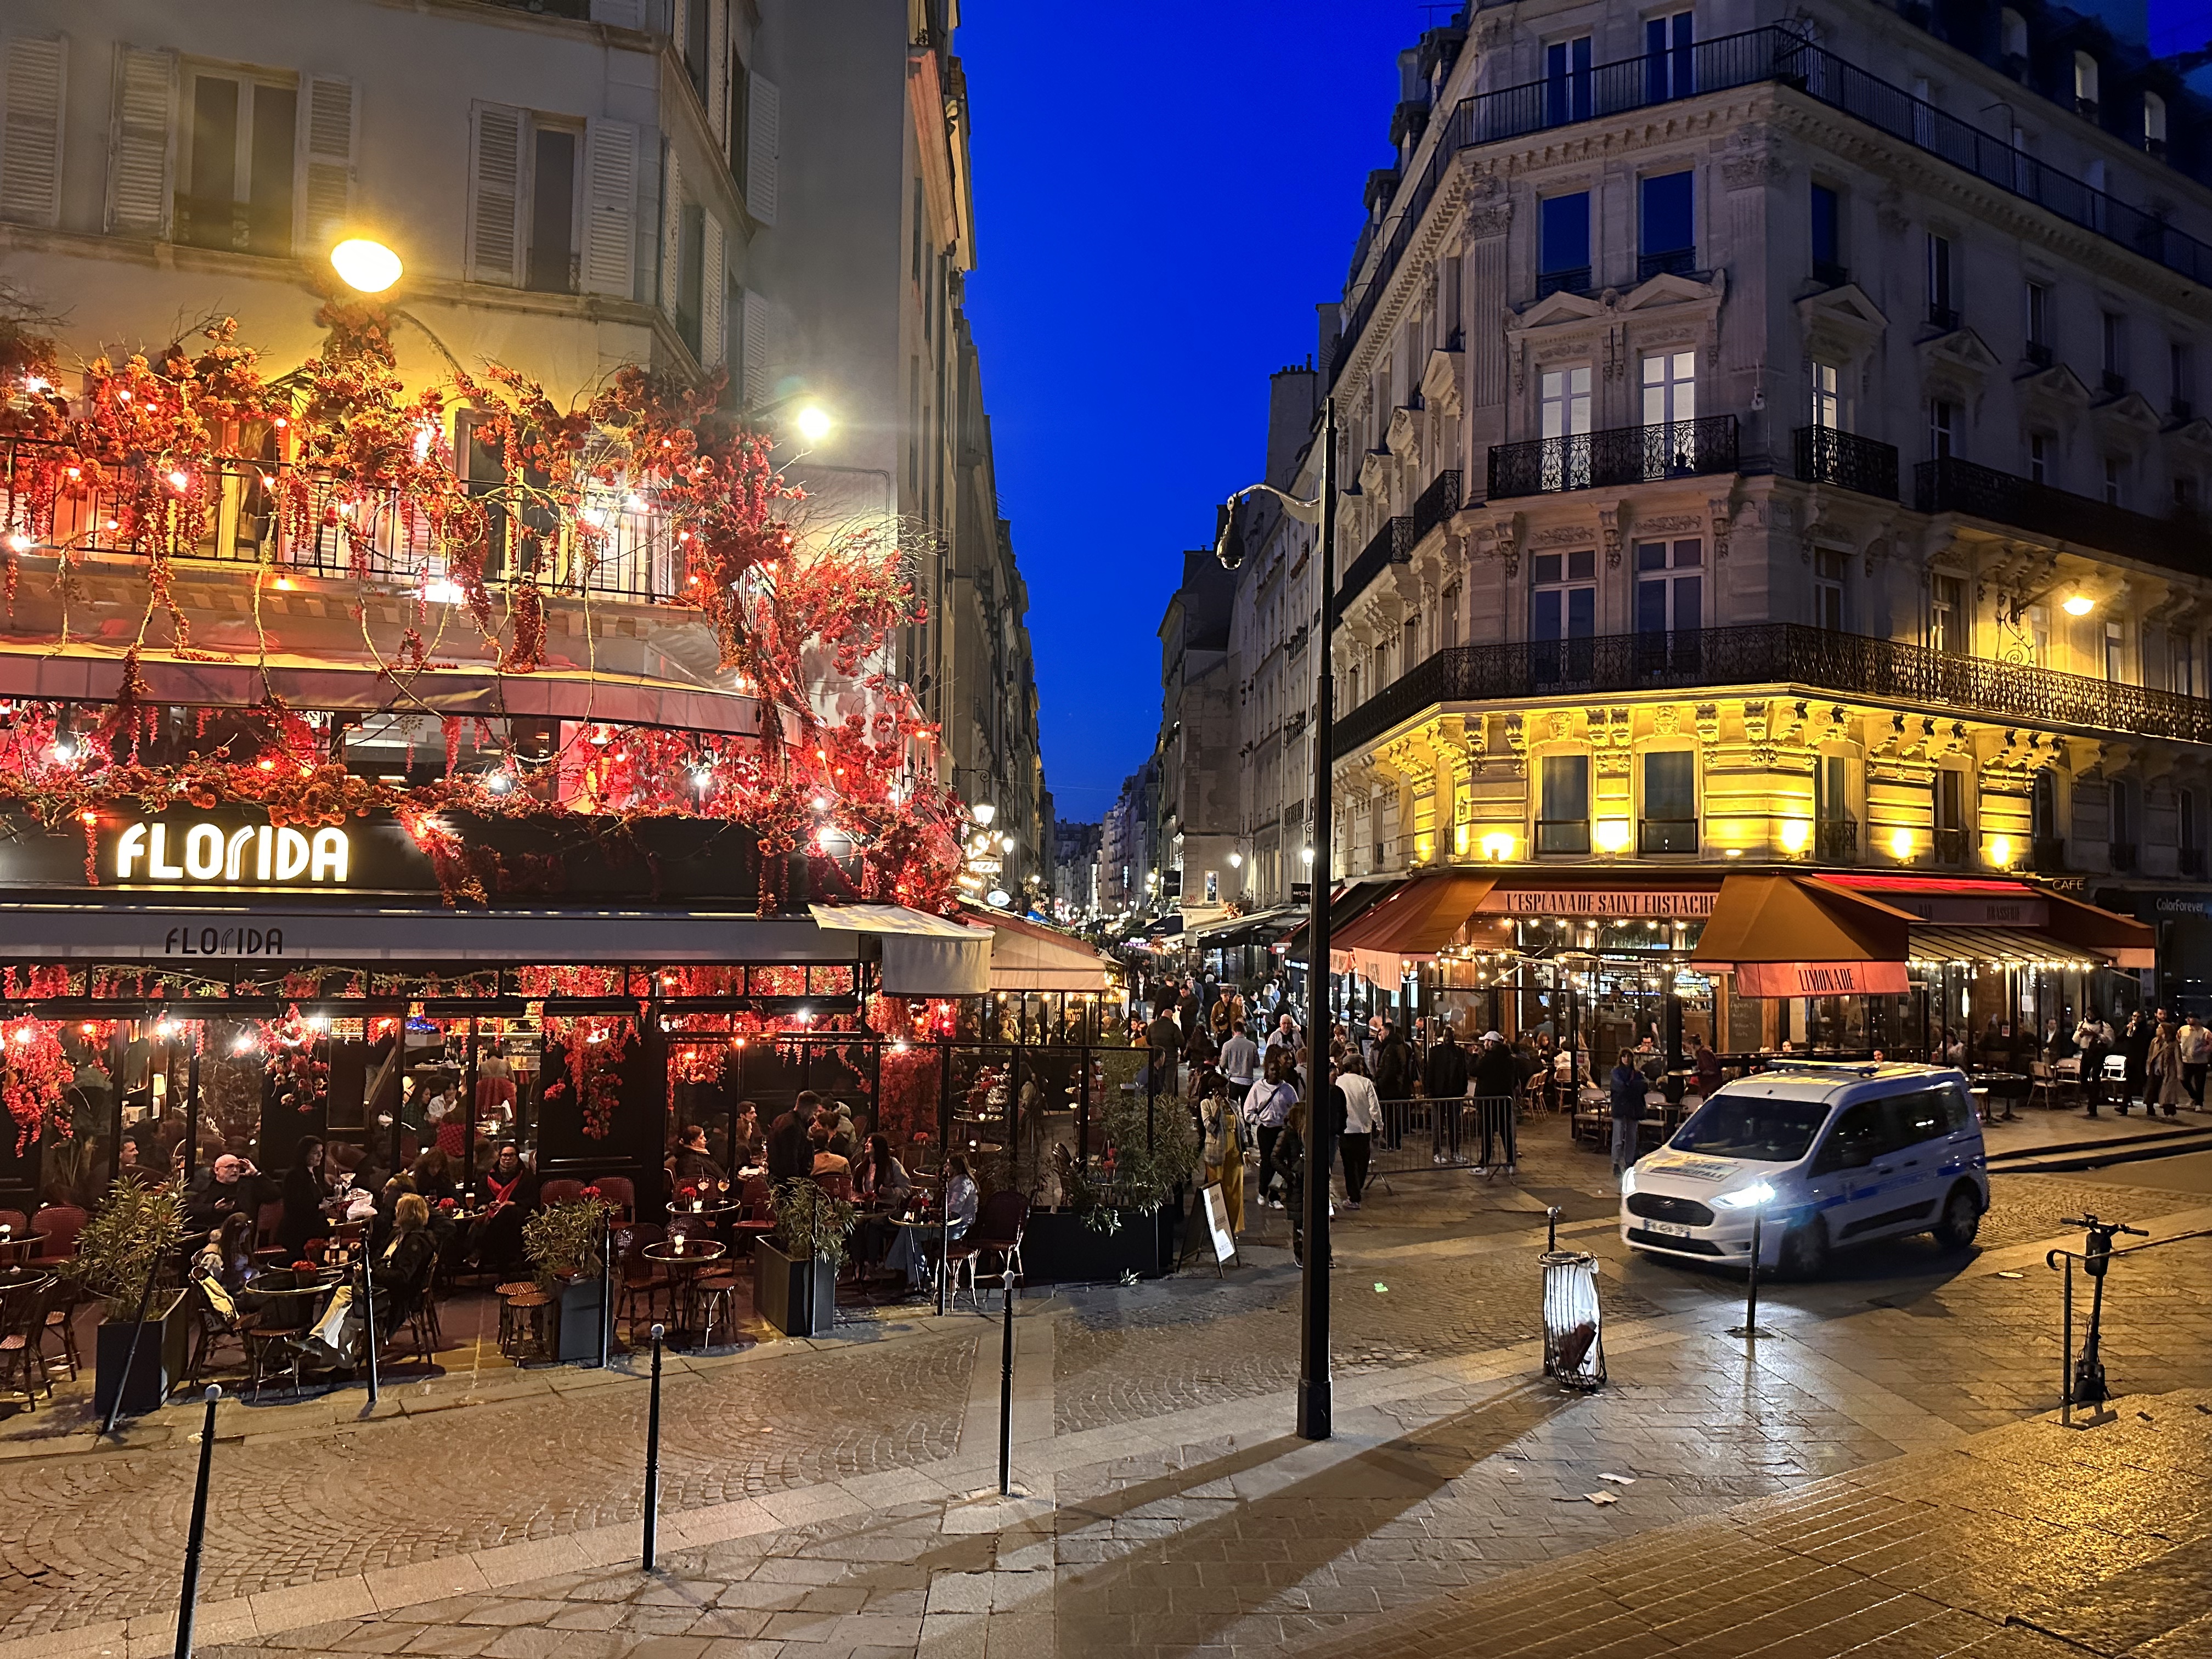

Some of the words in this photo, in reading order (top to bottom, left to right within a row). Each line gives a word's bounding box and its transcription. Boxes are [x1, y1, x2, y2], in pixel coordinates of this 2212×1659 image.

[117, 822, 349, 882] FLORIDA
[1506, 893, 1594, 912] L'ESPLANADE
[1598, 894, 1640, 912] SAINT
[1644, 895, 1719, 914] EUSTACHE
[1987, 905, 2020, 922] BRASSERIE
[2155, 898, 2203, 913] ColorForever
[165, 927, 283, 955] FLORIDA
[1798, 968, 1855, 992] LIMONADE
